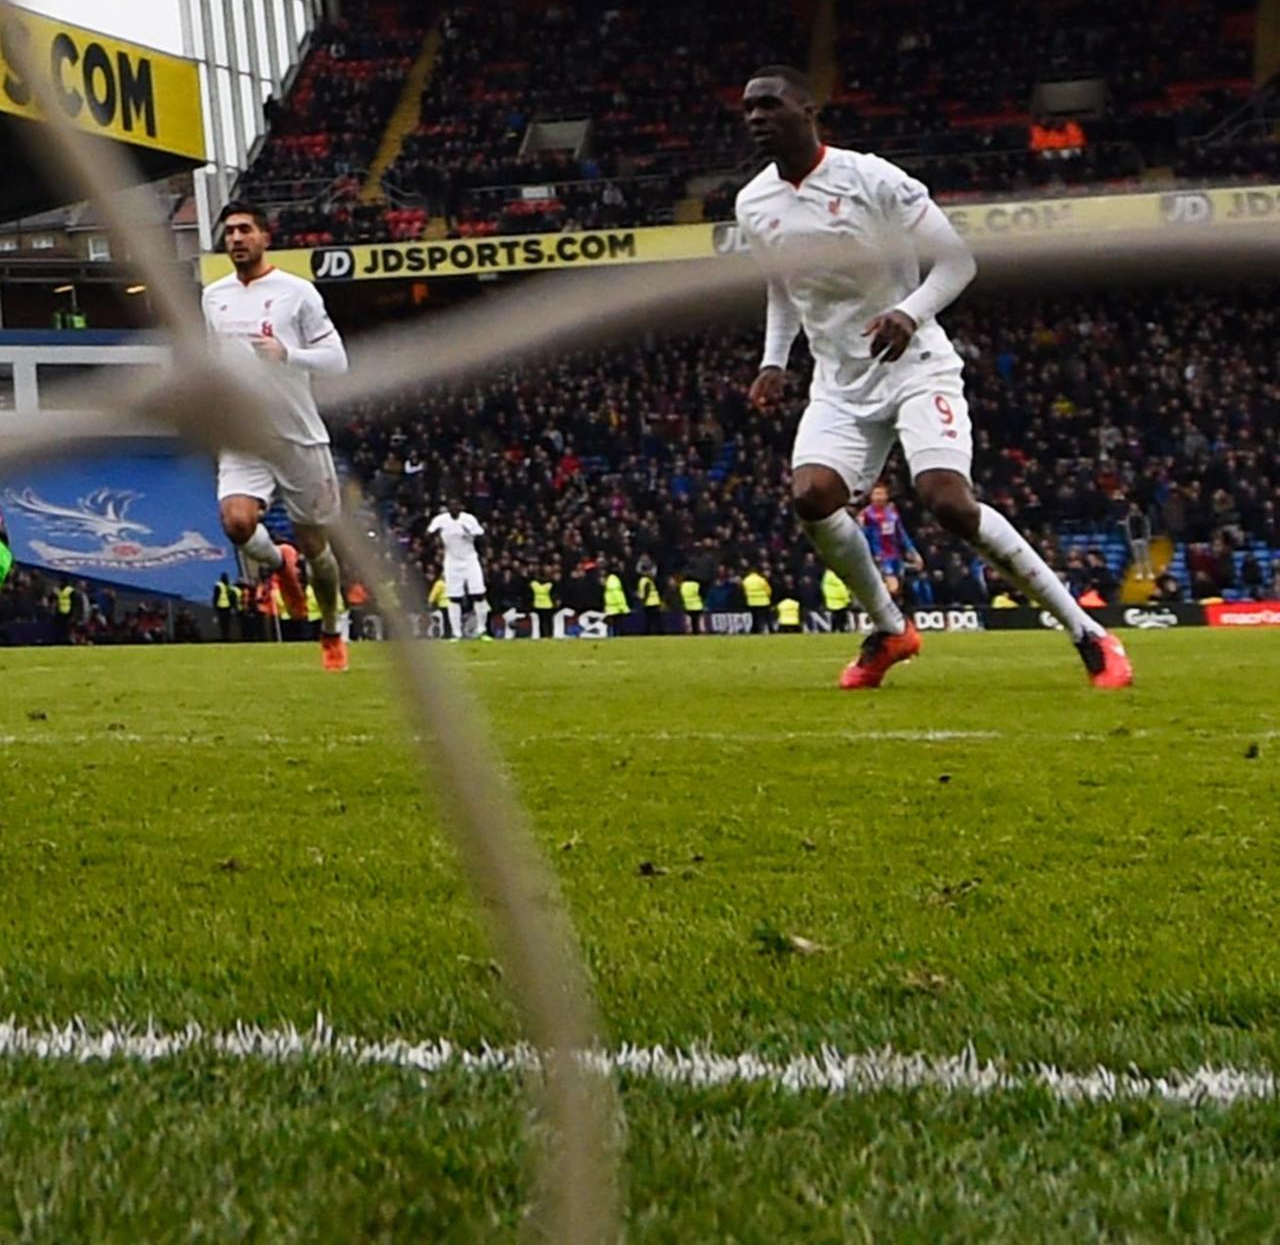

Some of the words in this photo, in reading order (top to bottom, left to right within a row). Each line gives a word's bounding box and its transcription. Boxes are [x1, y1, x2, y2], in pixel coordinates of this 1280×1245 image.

[316, 249, 353, 279] JD
[363, 231, 637, 275] JDSPORTS.COM
[934, 395, 954, 425] 9
